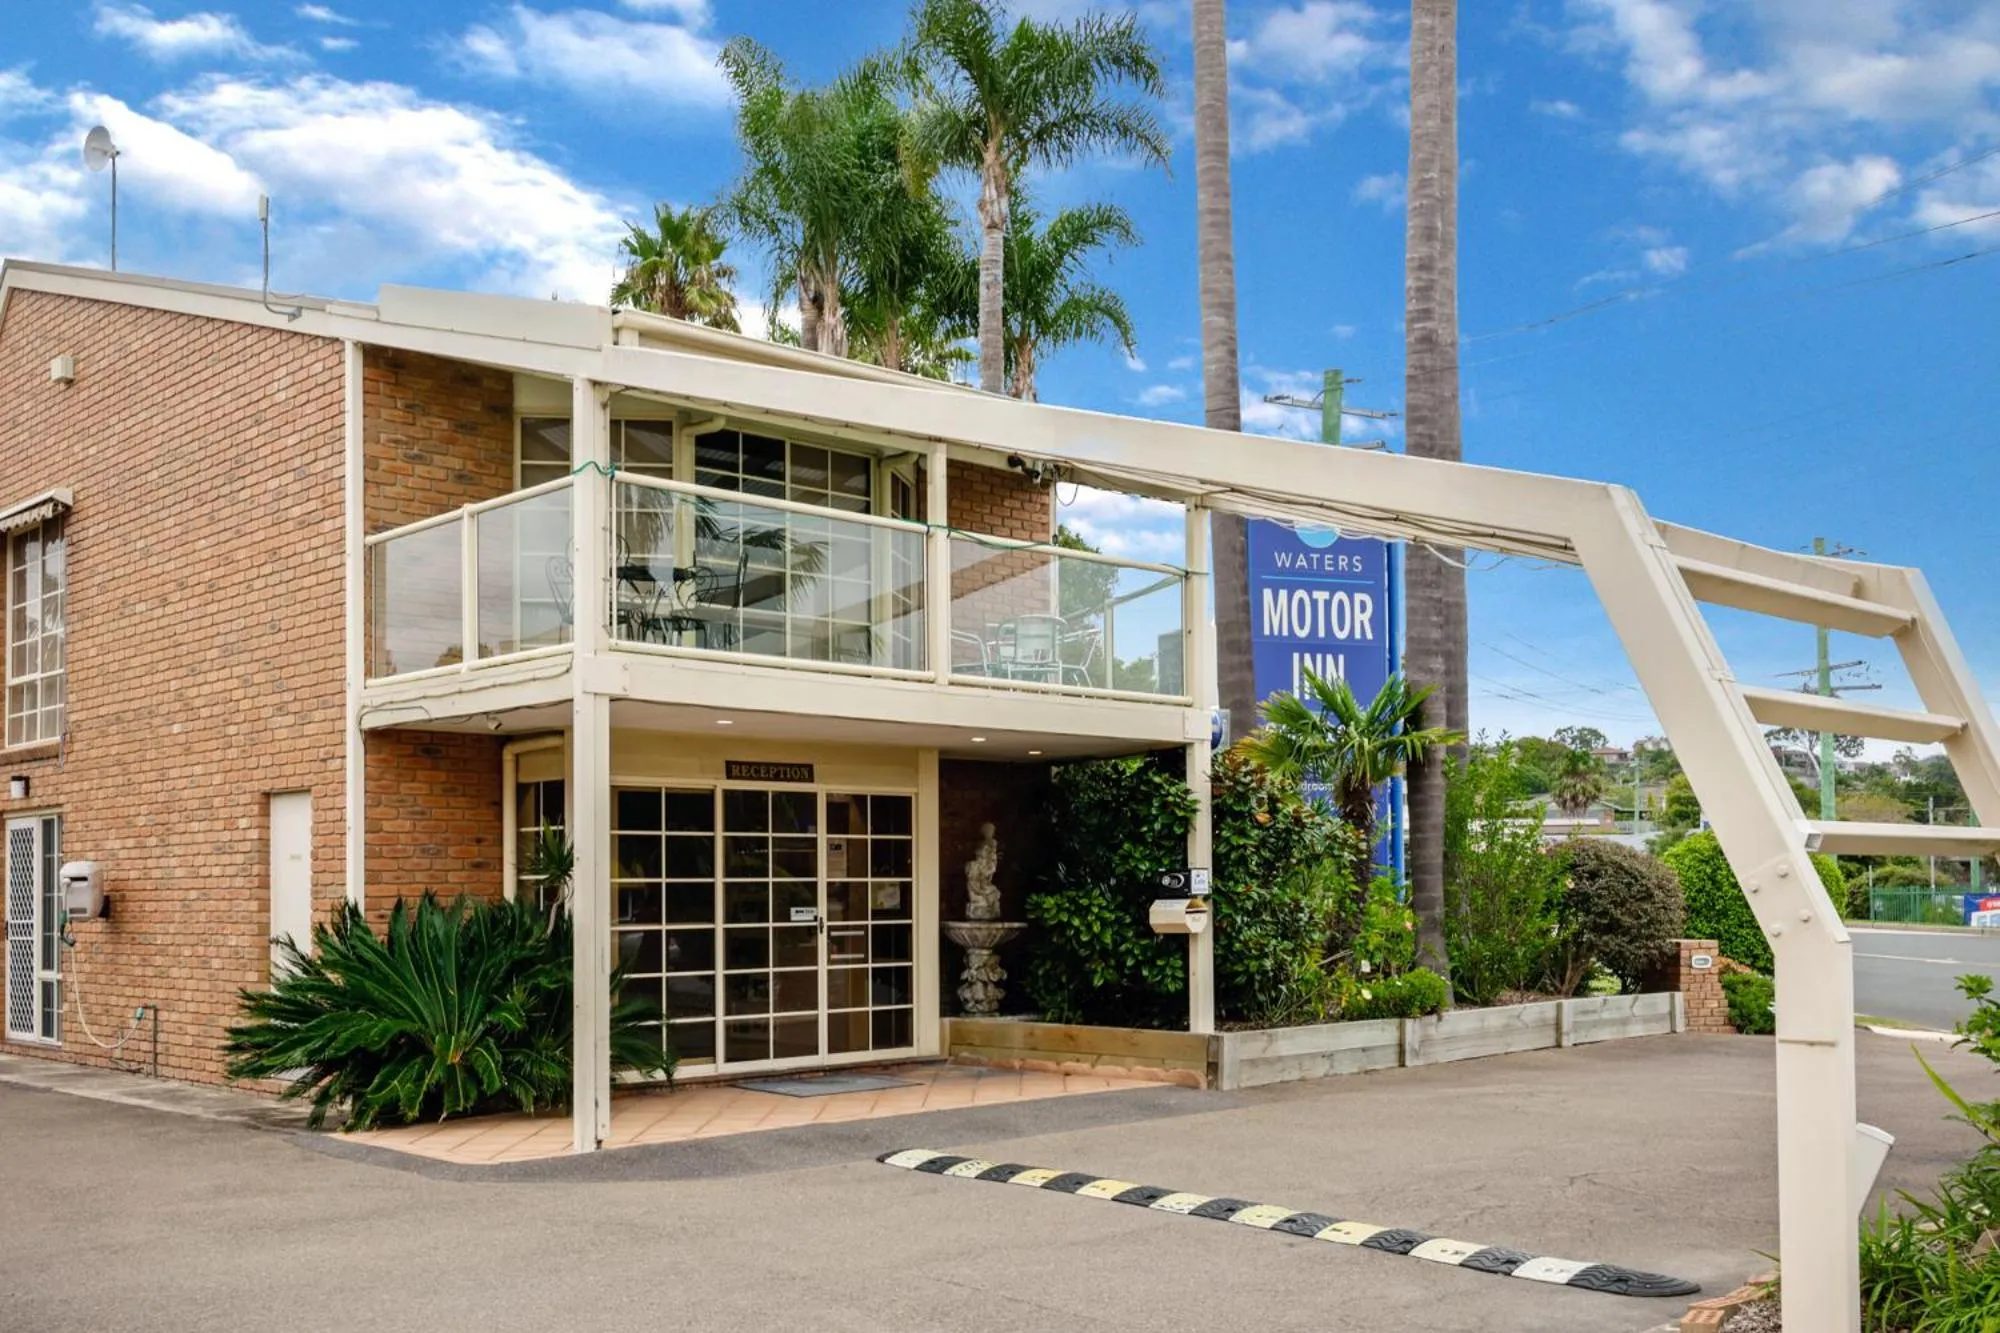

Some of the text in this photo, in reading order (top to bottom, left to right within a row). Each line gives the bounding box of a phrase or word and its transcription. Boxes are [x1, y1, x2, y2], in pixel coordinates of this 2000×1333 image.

[1274, 551, 1362, 572] WATERS
[1263, 588, 1373, 640] MOTOR
[1292, 652, 1345, 700] INN
[730, 764, 810, 779] RECEPTION
